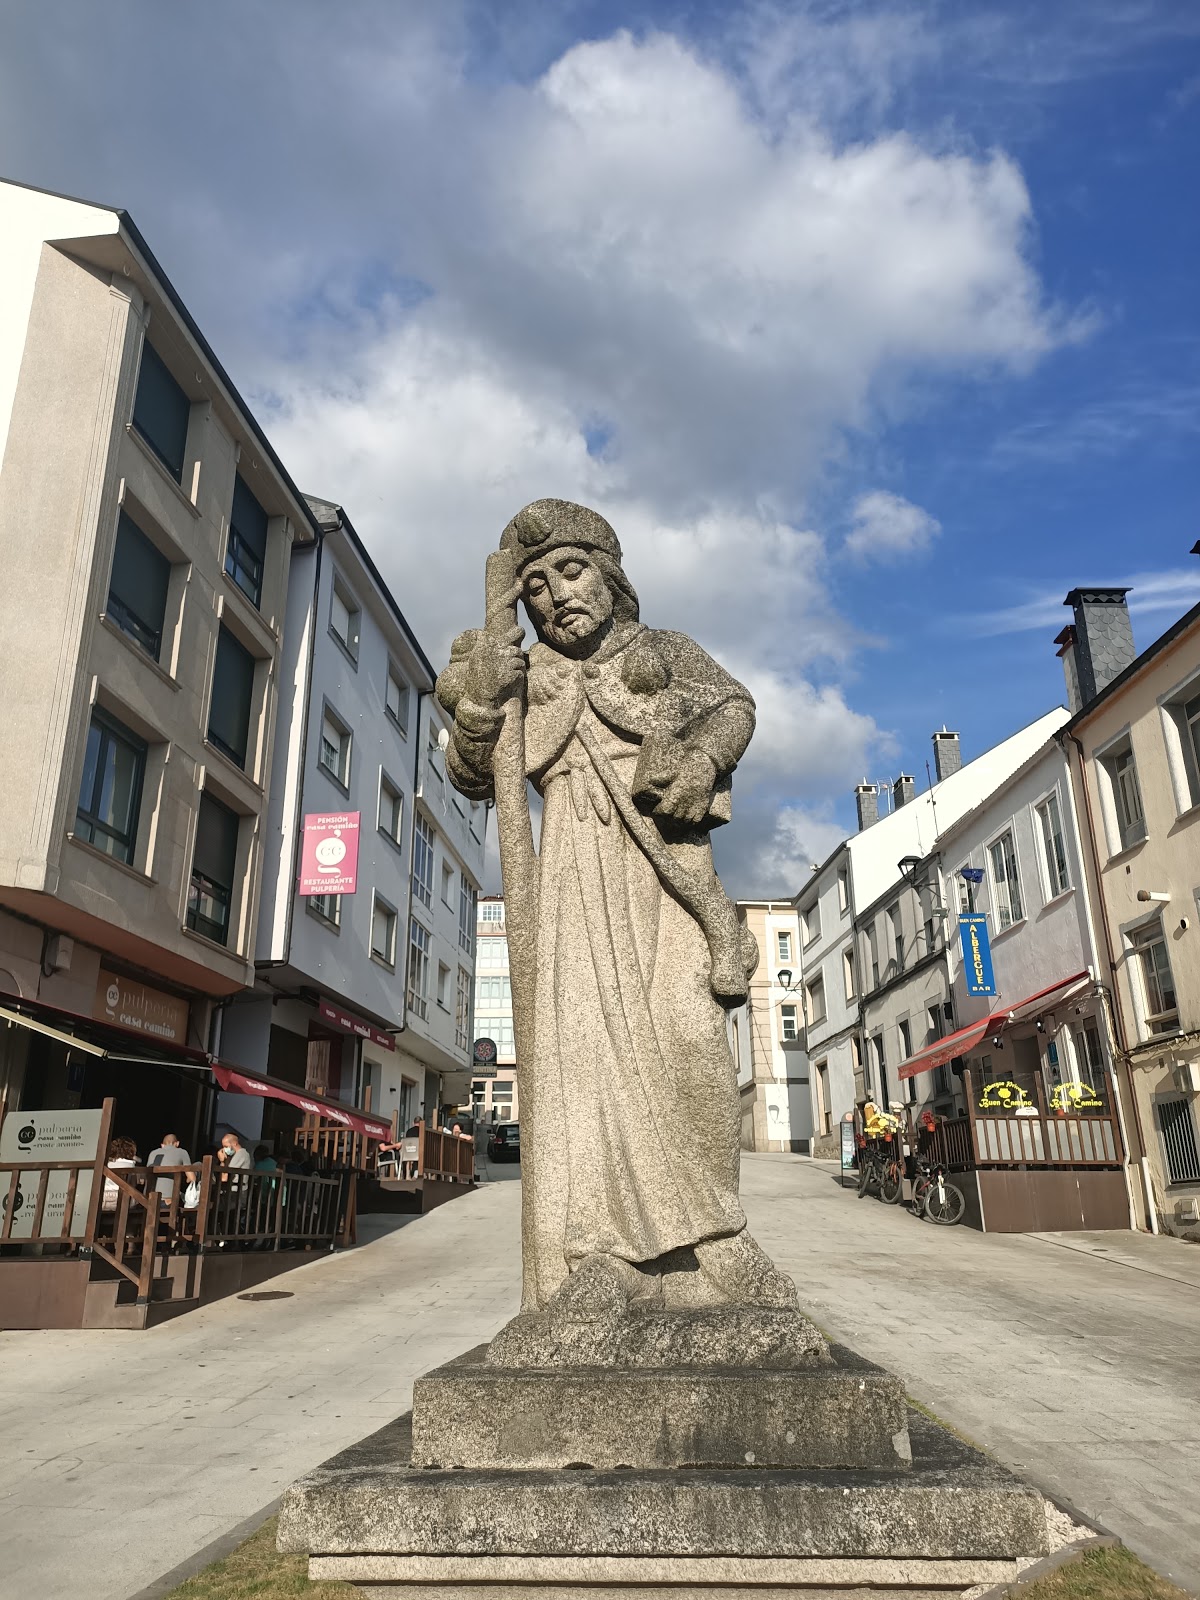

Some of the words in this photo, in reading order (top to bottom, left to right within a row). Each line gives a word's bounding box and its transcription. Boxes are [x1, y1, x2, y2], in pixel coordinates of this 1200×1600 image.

[317, 816, 348, 824] PENSIÓN
[303, 877, 353, 885] RESTAURANTE
[970, 924, 984, 984] ALBERGUE
[119, 1013, 142, 1028] casa
[979, 1098, 1001, 1108] Buen
[1074, 1098, 1102, 1108] Camino
